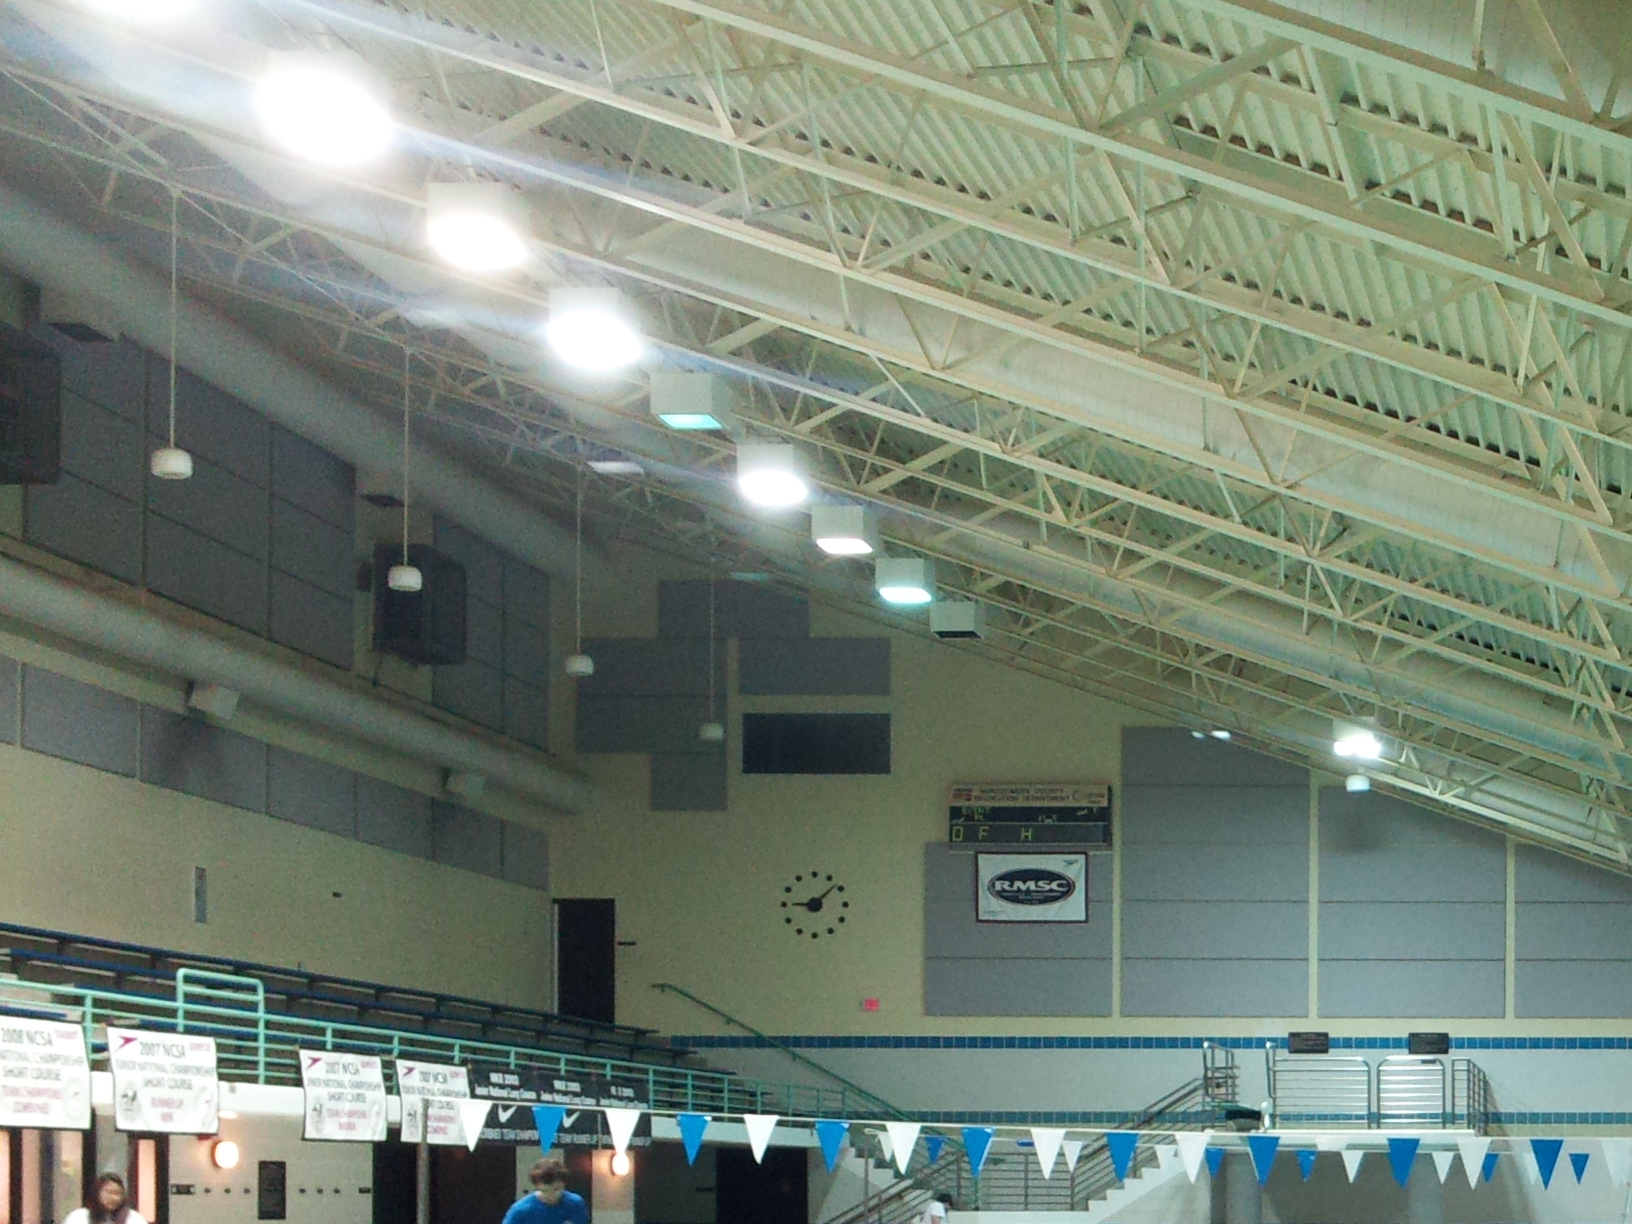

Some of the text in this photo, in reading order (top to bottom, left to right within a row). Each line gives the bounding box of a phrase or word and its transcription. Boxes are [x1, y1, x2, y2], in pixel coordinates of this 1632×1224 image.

[994, 880, 1068, 891] RMSC
[26, 1030, 54, 1046] NCSA
[162, 1043, 187, 1058] NCSA
